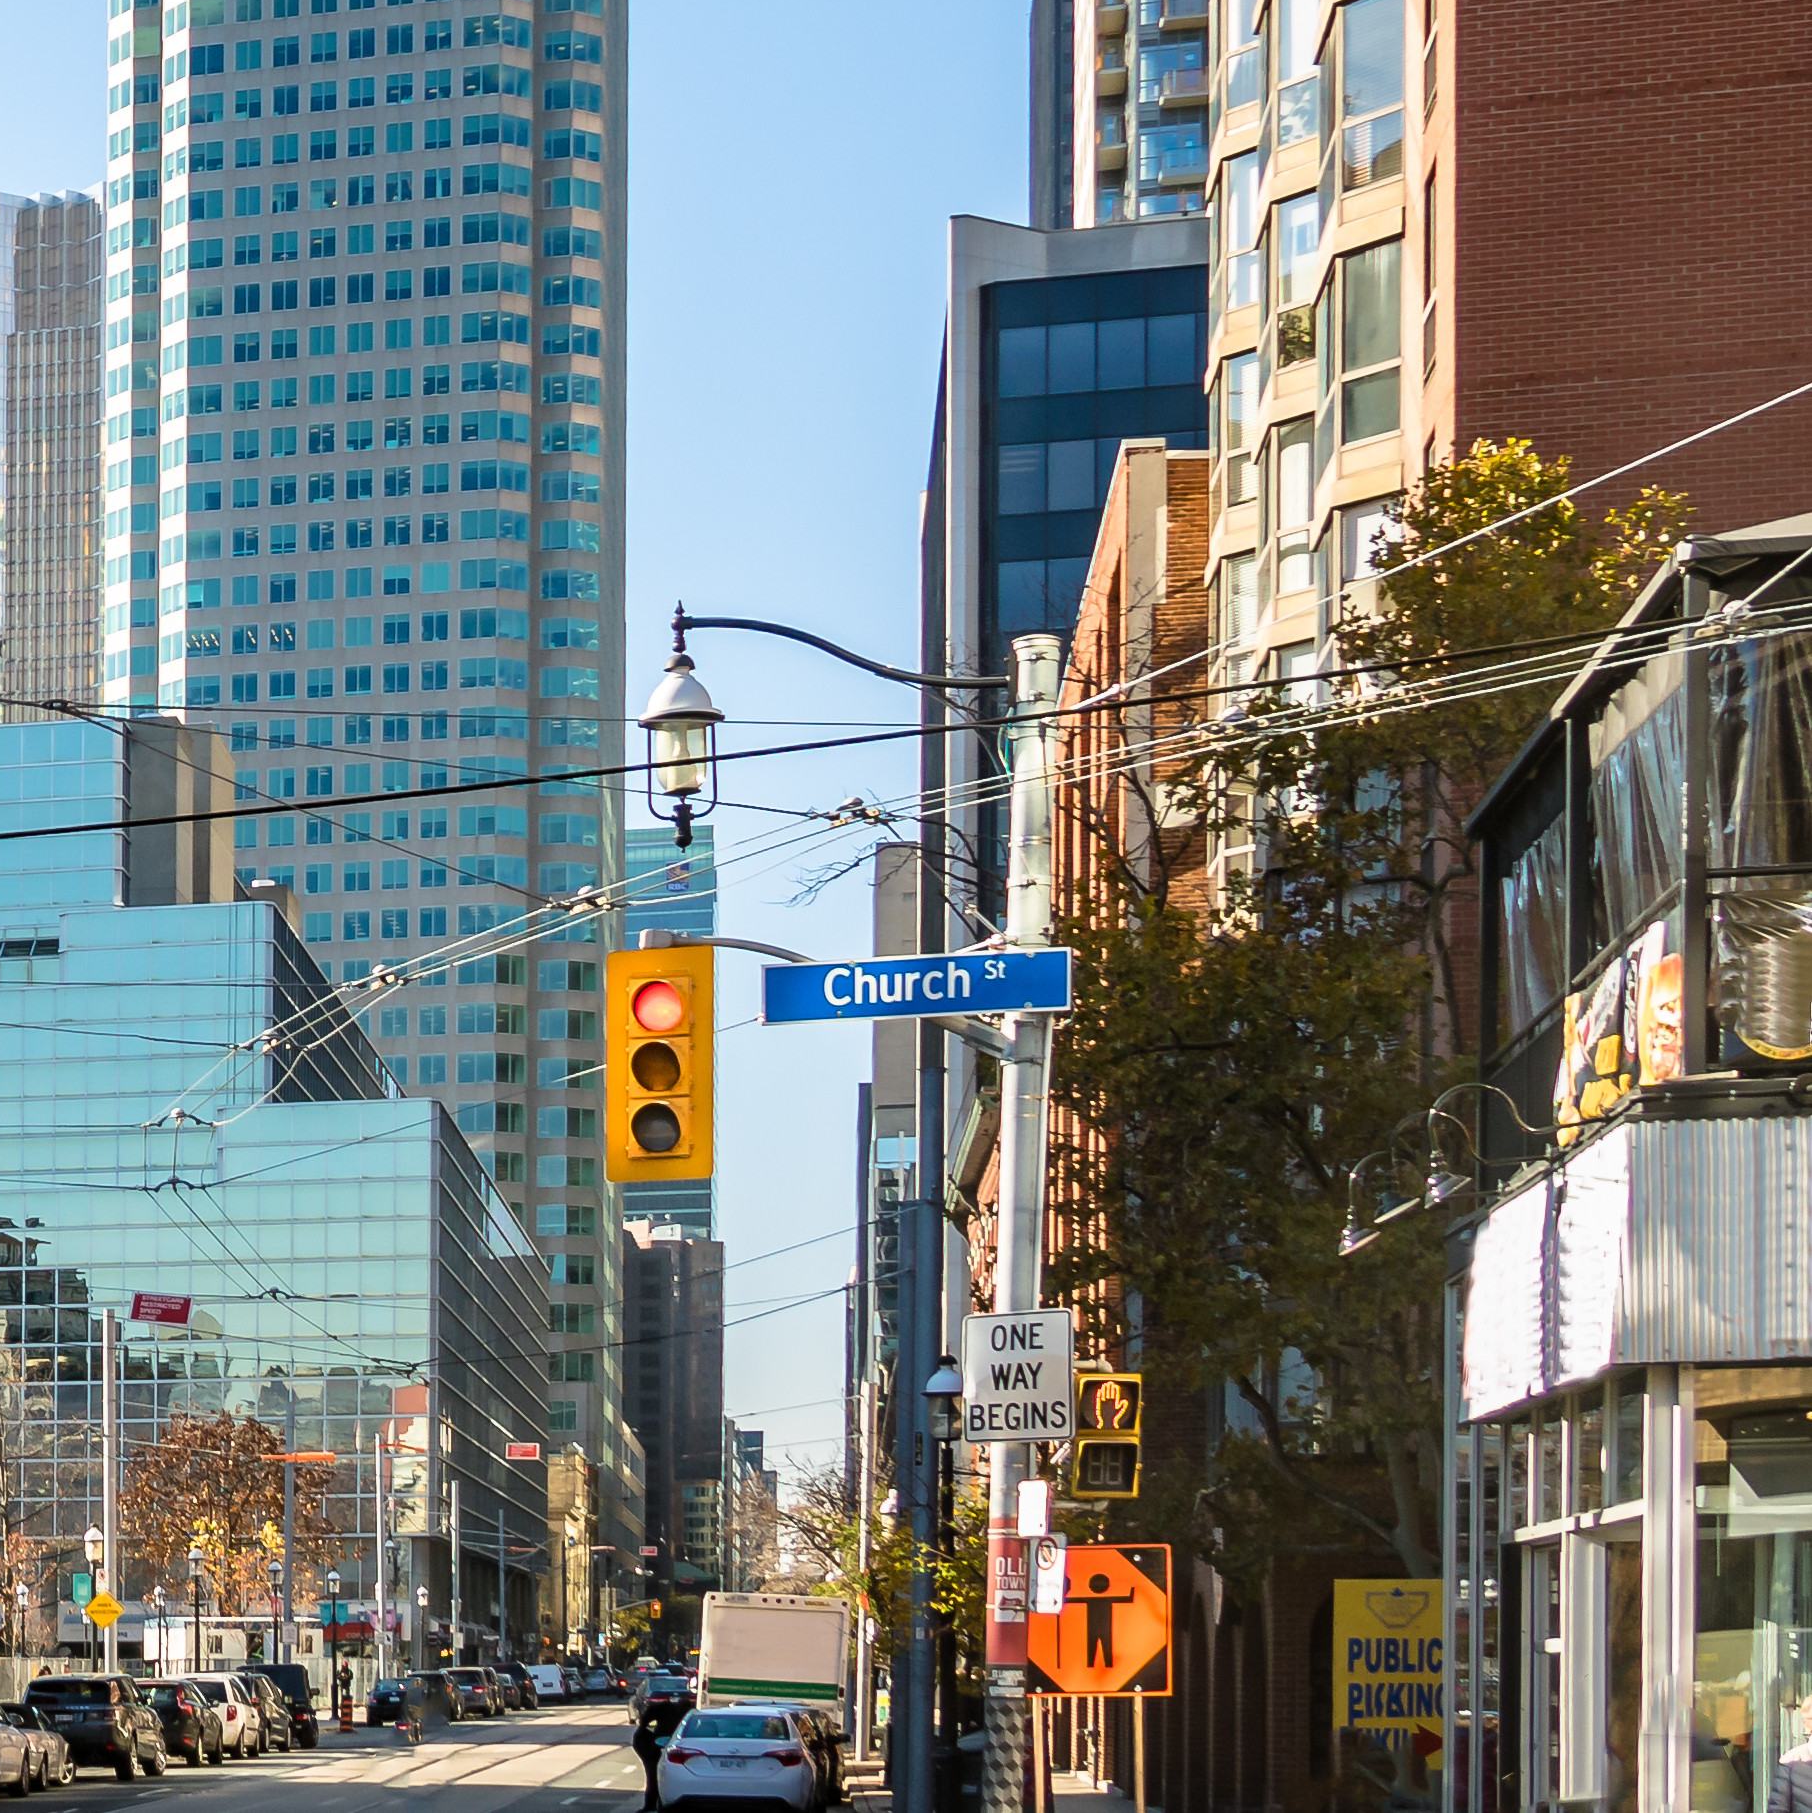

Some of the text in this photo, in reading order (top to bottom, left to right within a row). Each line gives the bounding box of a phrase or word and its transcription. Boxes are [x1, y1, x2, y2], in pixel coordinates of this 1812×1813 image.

[824, 959, 1007, 1006] Church St
[991, 1322, 1044, 1352] ONE
[990, 1361, 1043, 1391] WAY
[969, 1400, 1067, 1432] BEGINS
[995, 1576, 1026, 1590] TOWN
[1347, 1637, 1443, 1673] PUBLIC
